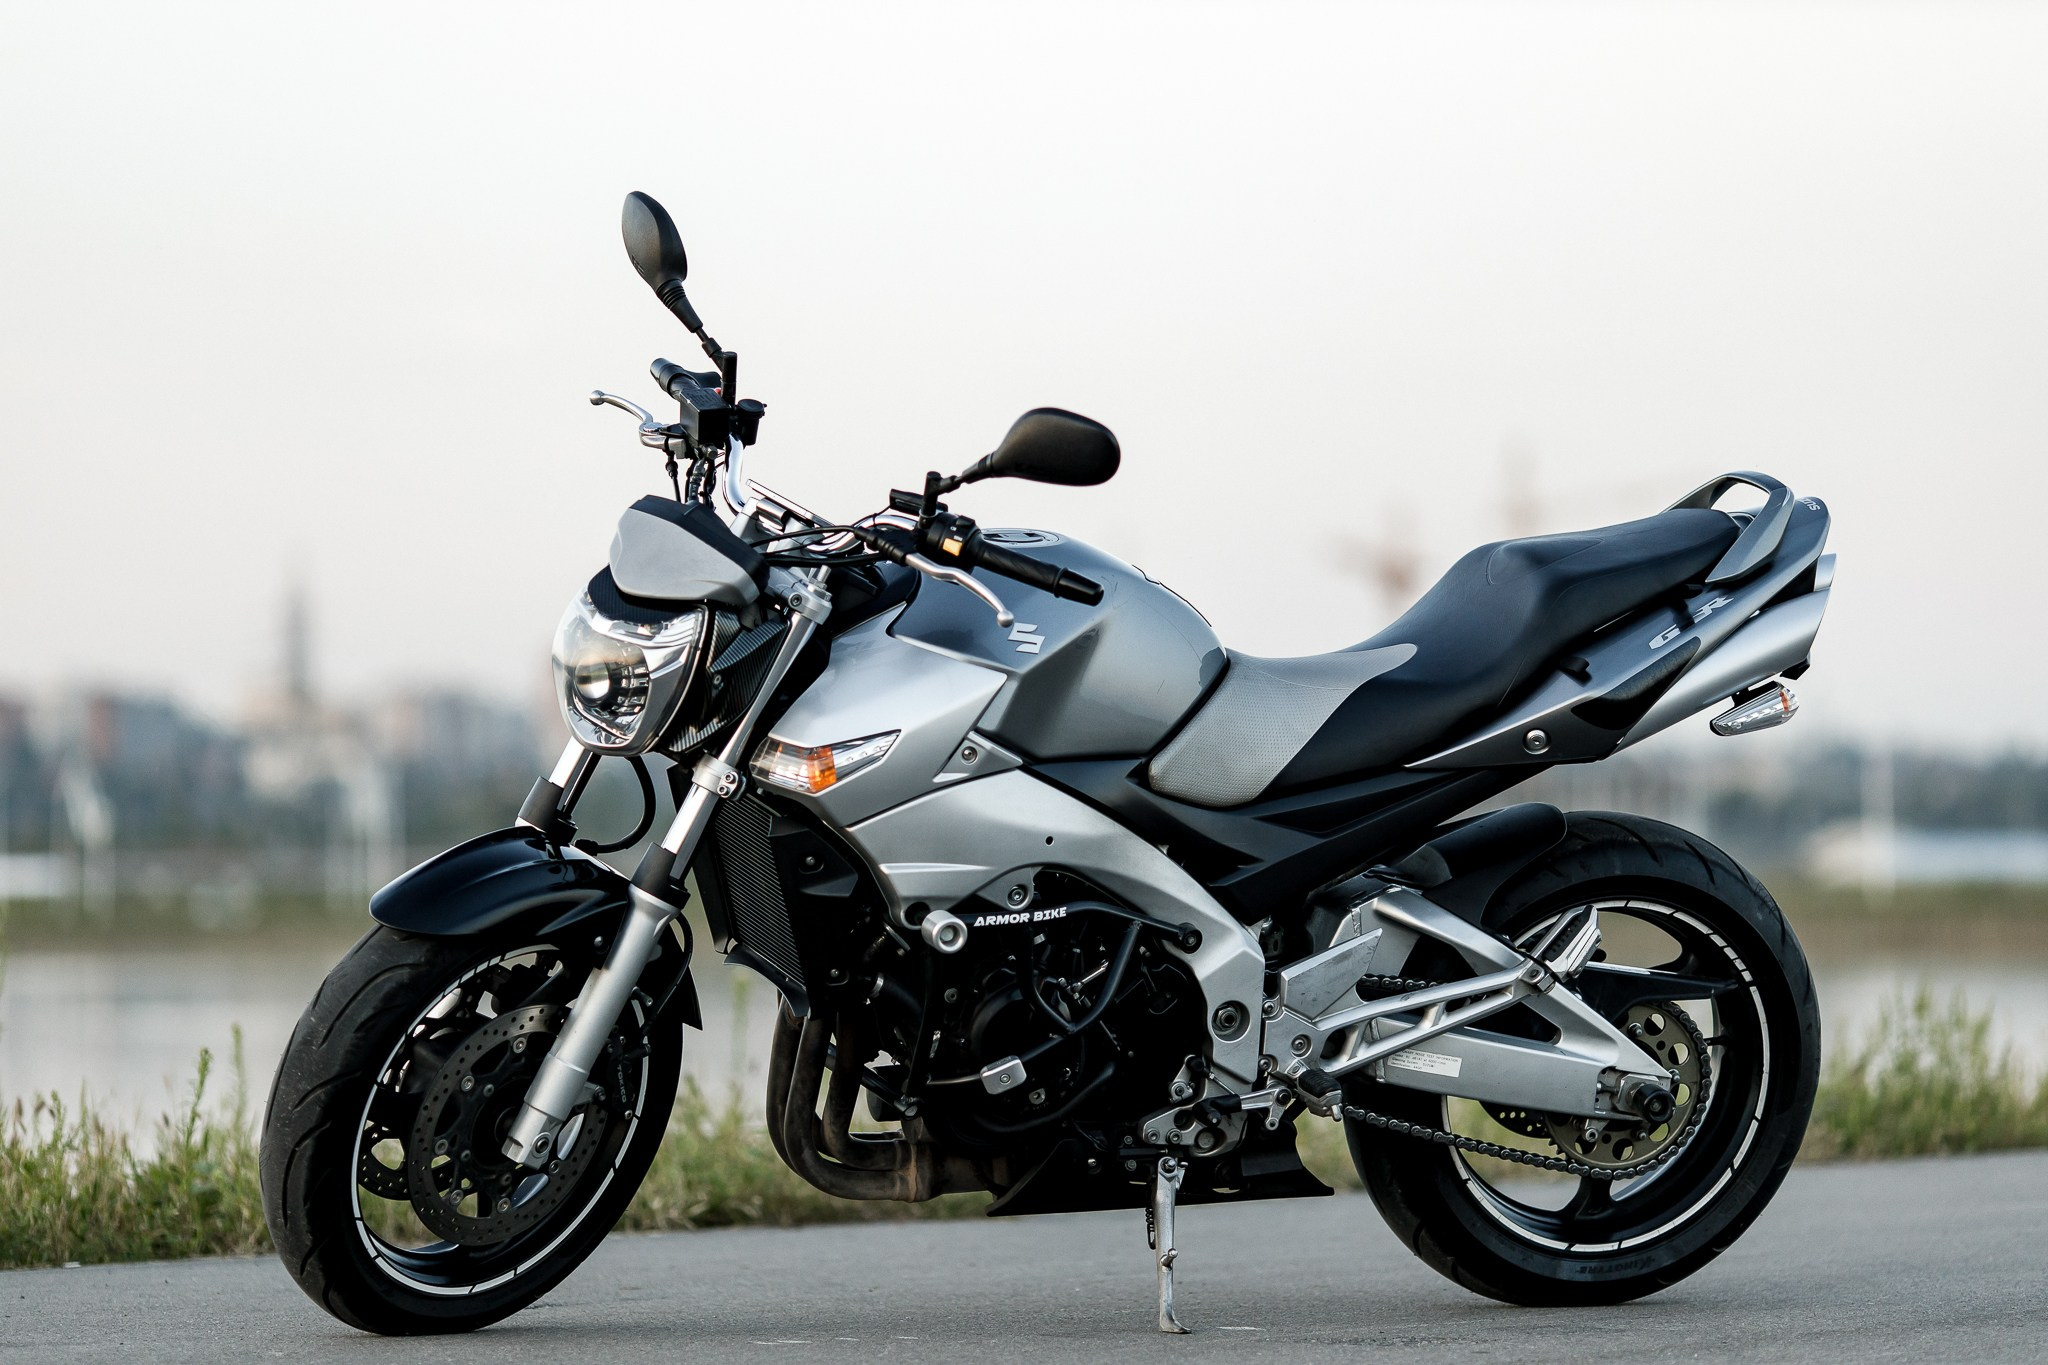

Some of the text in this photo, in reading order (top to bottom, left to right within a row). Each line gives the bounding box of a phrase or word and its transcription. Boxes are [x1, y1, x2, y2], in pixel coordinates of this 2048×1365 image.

[974, 907, 1067, 927] ARMOR BIKE
[617, 1064, 627, 1103] TOKICO
